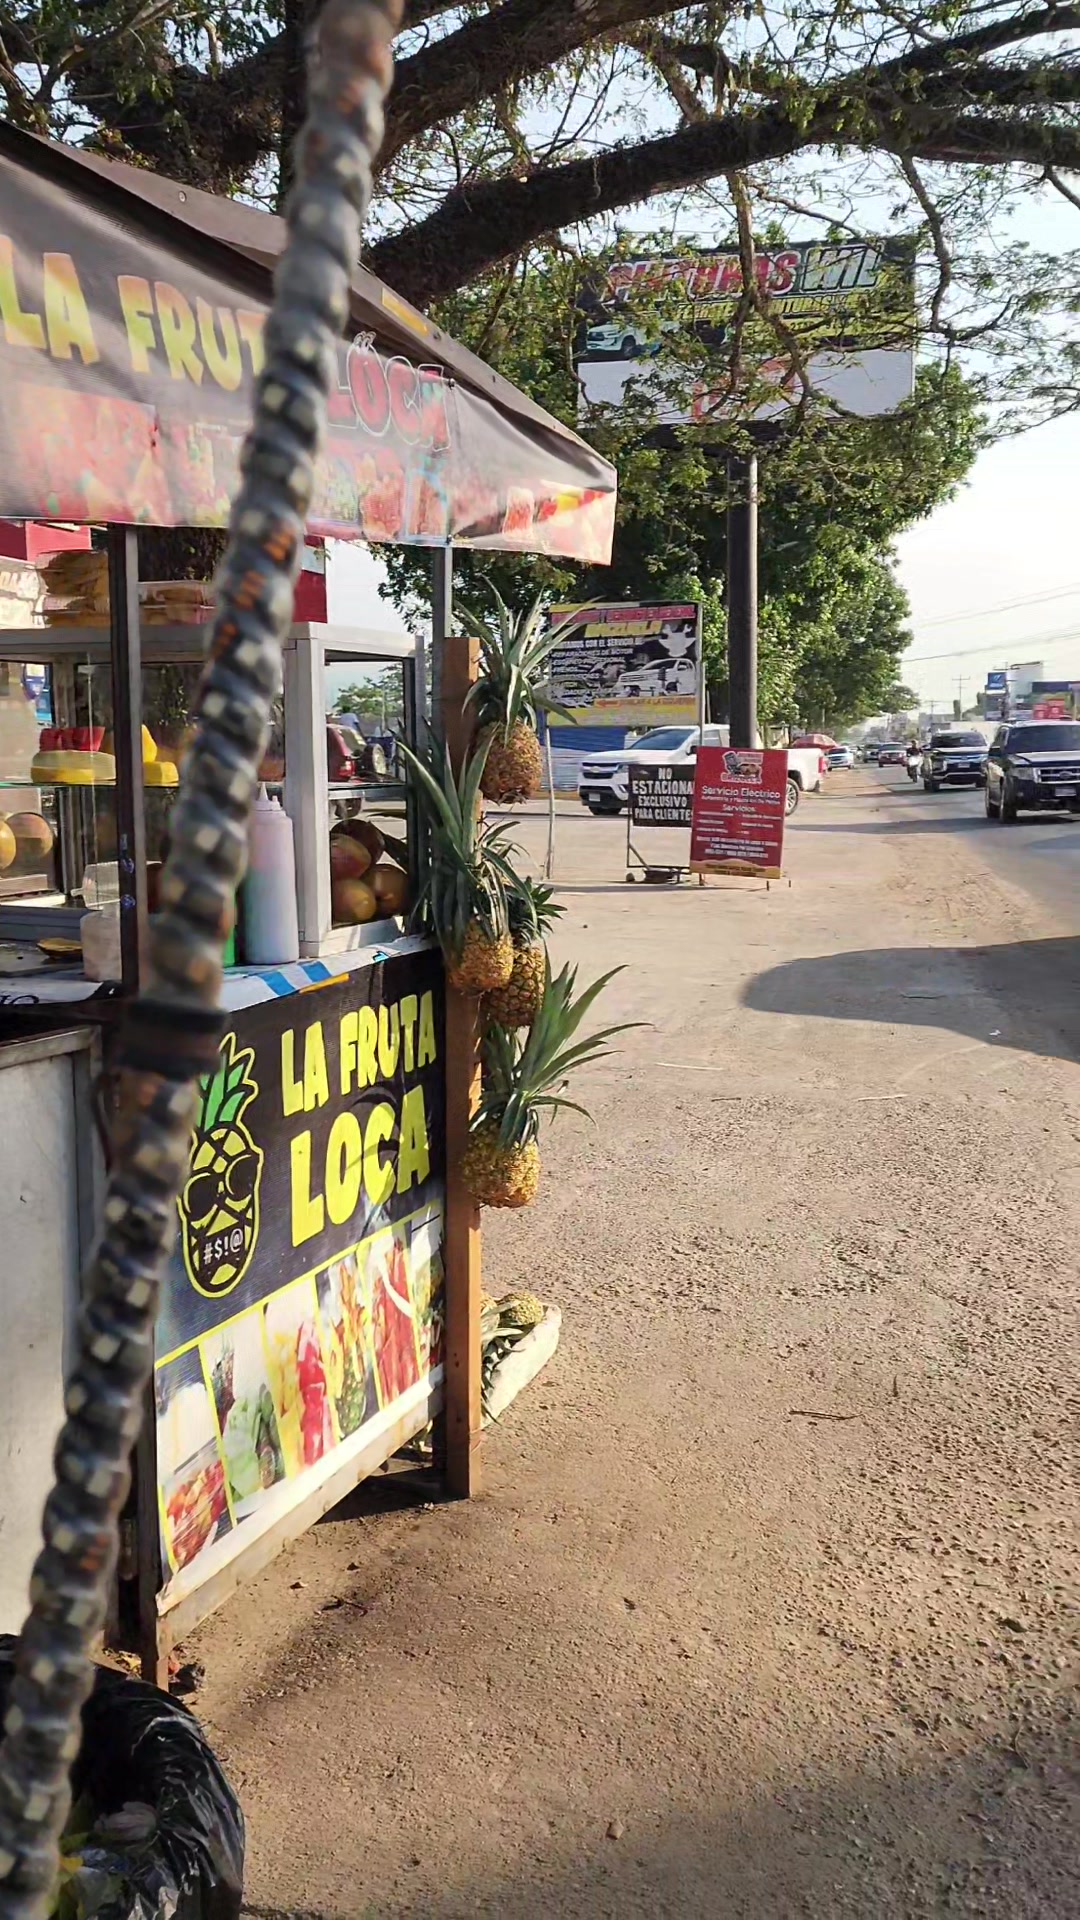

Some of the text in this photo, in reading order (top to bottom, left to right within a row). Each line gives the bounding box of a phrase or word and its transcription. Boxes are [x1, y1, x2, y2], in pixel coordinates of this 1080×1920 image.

[0, 234, 97, 364] LA
[117, 275, 268, 391] FRUT
[658, 767, 673, 780] NO
[632, 780, 695, 794] ESTACIONA
[702, 785, 739, 796] Servicio
[638, 795, 687, 807] EXCLUSIVO
[634, 807, 653, 819] PARA
[654, 808, 693, 820] CLIENTE
[281, 990, 437, 1117] LA FRUTA
[290, 1084, 431, 1248] LOCA
